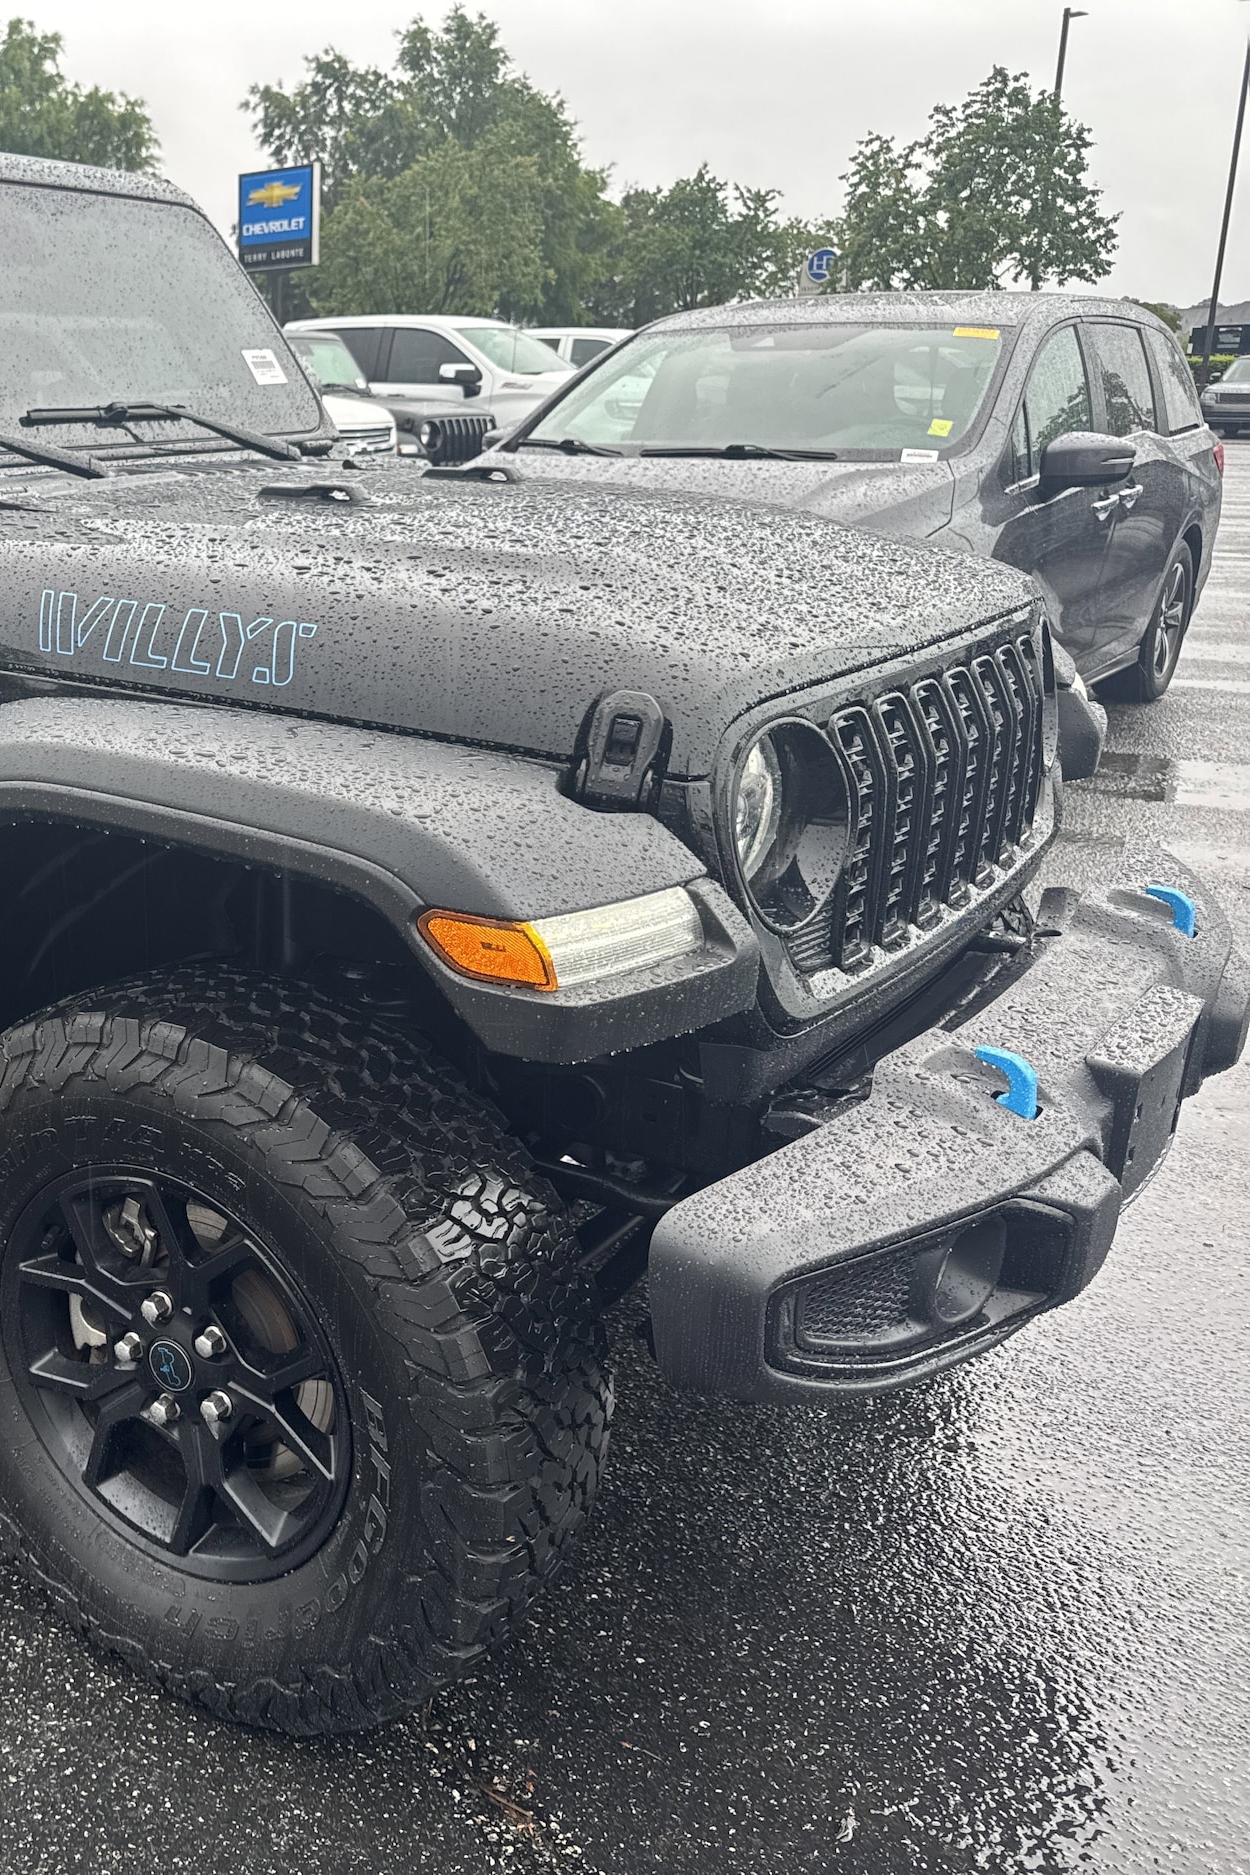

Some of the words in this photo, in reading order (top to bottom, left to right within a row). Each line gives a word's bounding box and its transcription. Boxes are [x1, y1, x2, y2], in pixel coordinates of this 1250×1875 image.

[242, 217, 305, 236] CHEVROLET
[244, 252, 267, 263] TERRY
[271, 248, 304, 260] LABONTE
[38, 589, 317, 686] WILLYS
